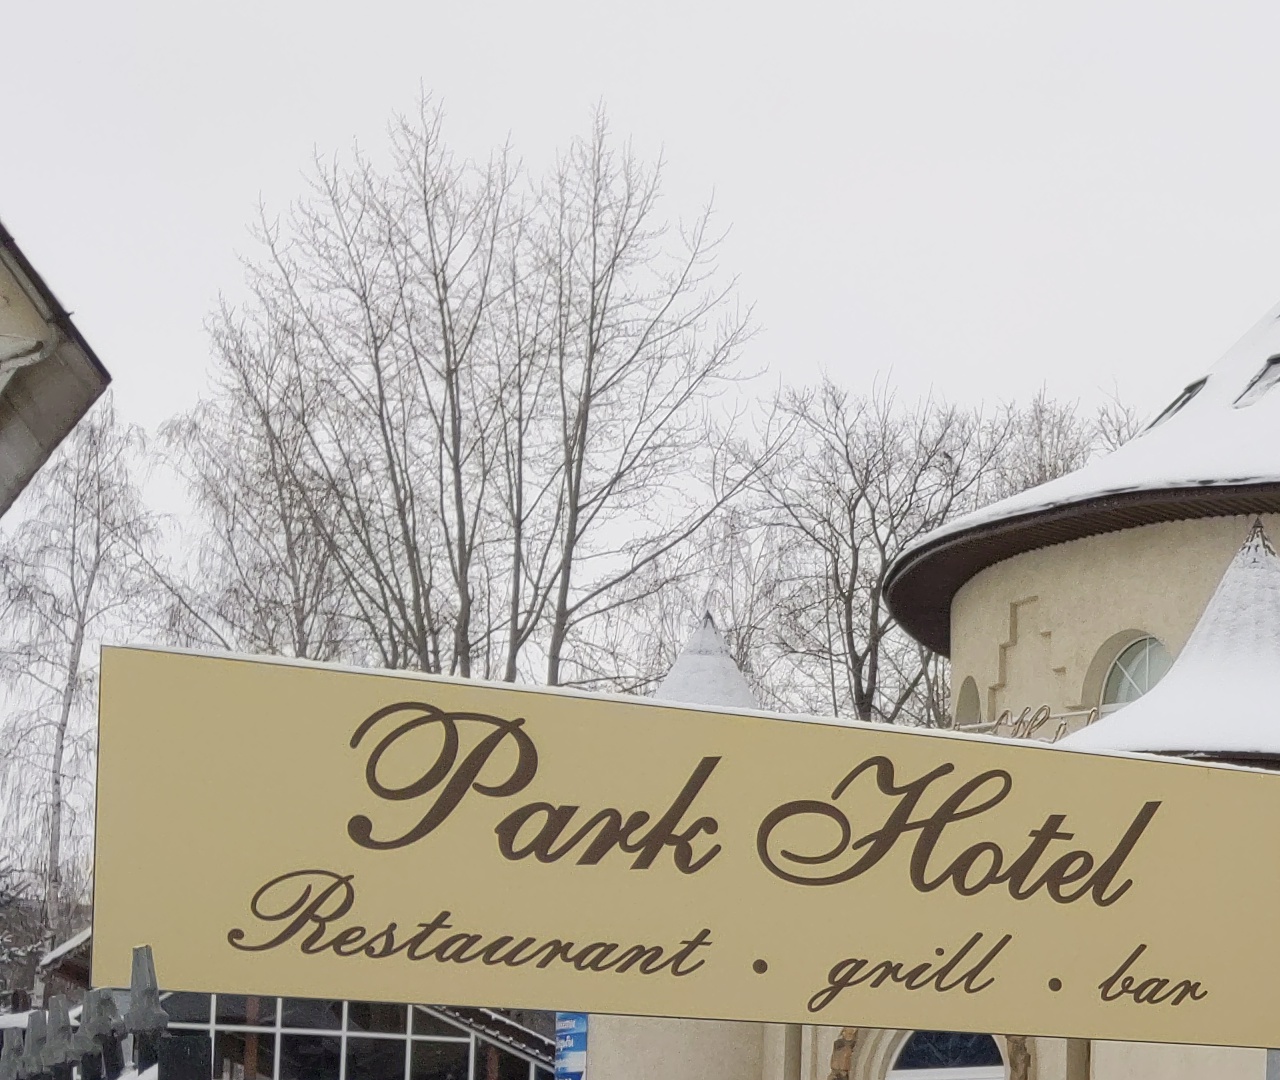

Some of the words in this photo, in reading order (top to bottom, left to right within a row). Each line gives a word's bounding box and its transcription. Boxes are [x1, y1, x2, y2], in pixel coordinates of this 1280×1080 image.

[347, 701, 723, 875] Park
[756, 755, 1163, 908] Hotel
[227, 869, 713, 977] Restaurant
[807, 931, 1013, 1013] grill
[1097, 943, 1209, 1006] bar
